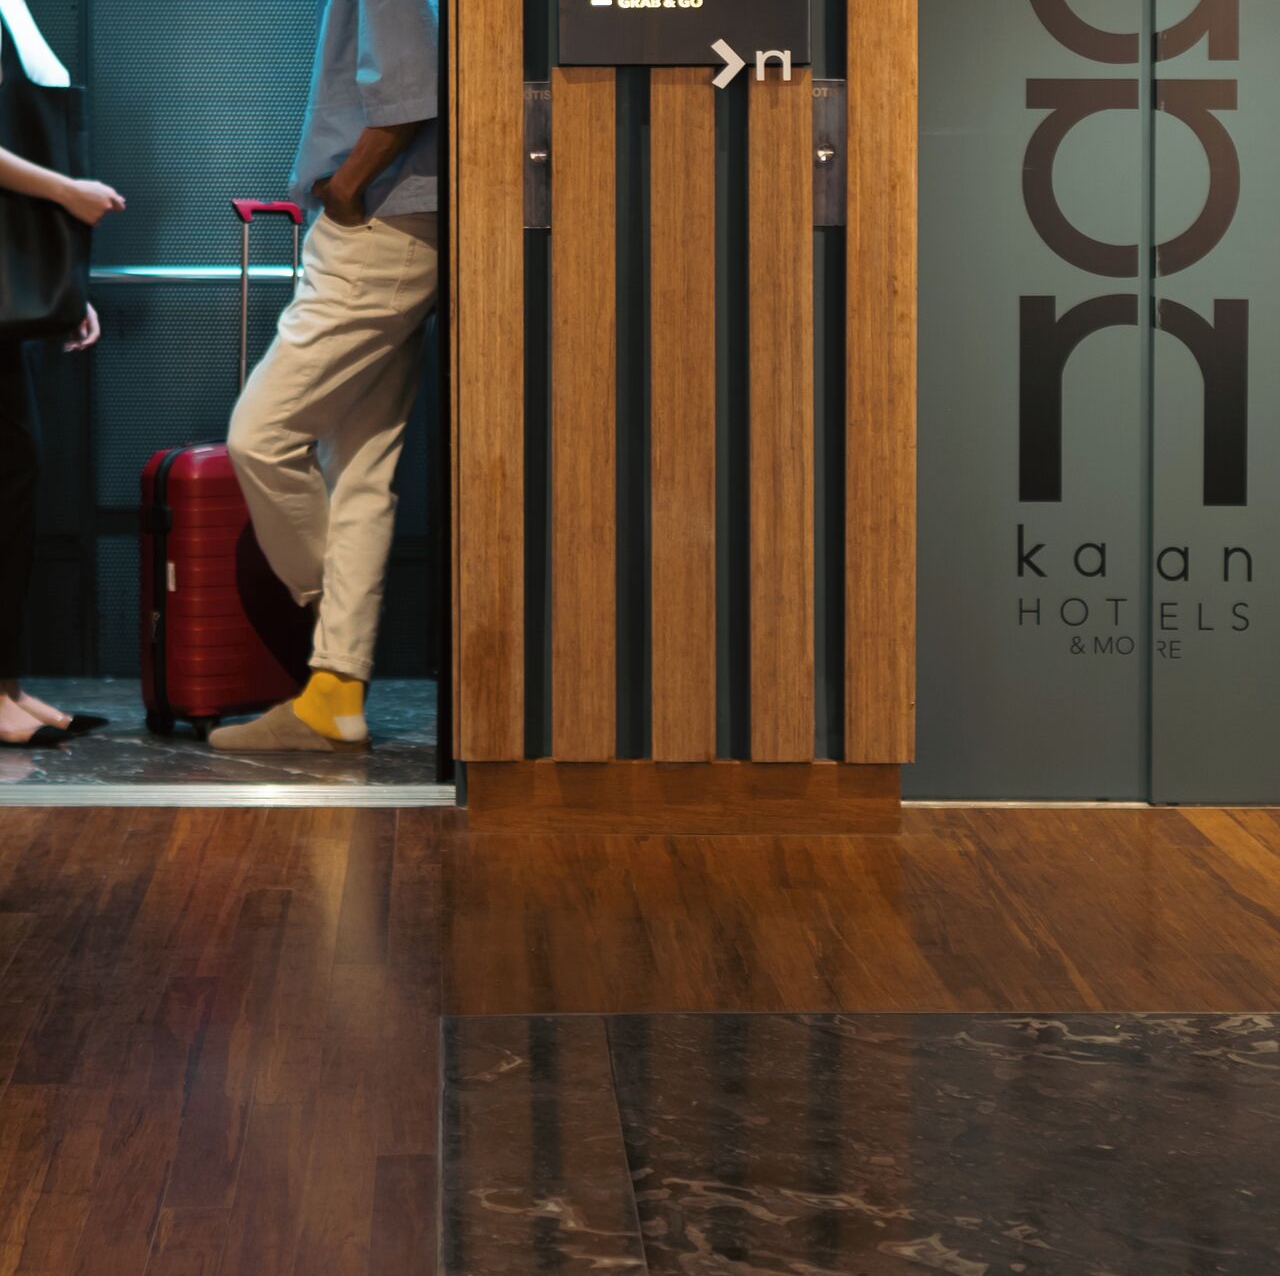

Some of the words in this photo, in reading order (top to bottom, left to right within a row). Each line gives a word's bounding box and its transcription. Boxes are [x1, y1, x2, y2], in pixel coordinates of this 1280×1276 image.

[1017, 524, 1253, 582] kaan
[1019, 598, 1250, 632] HOTELS
[1071, 636, 1086, 655] &
